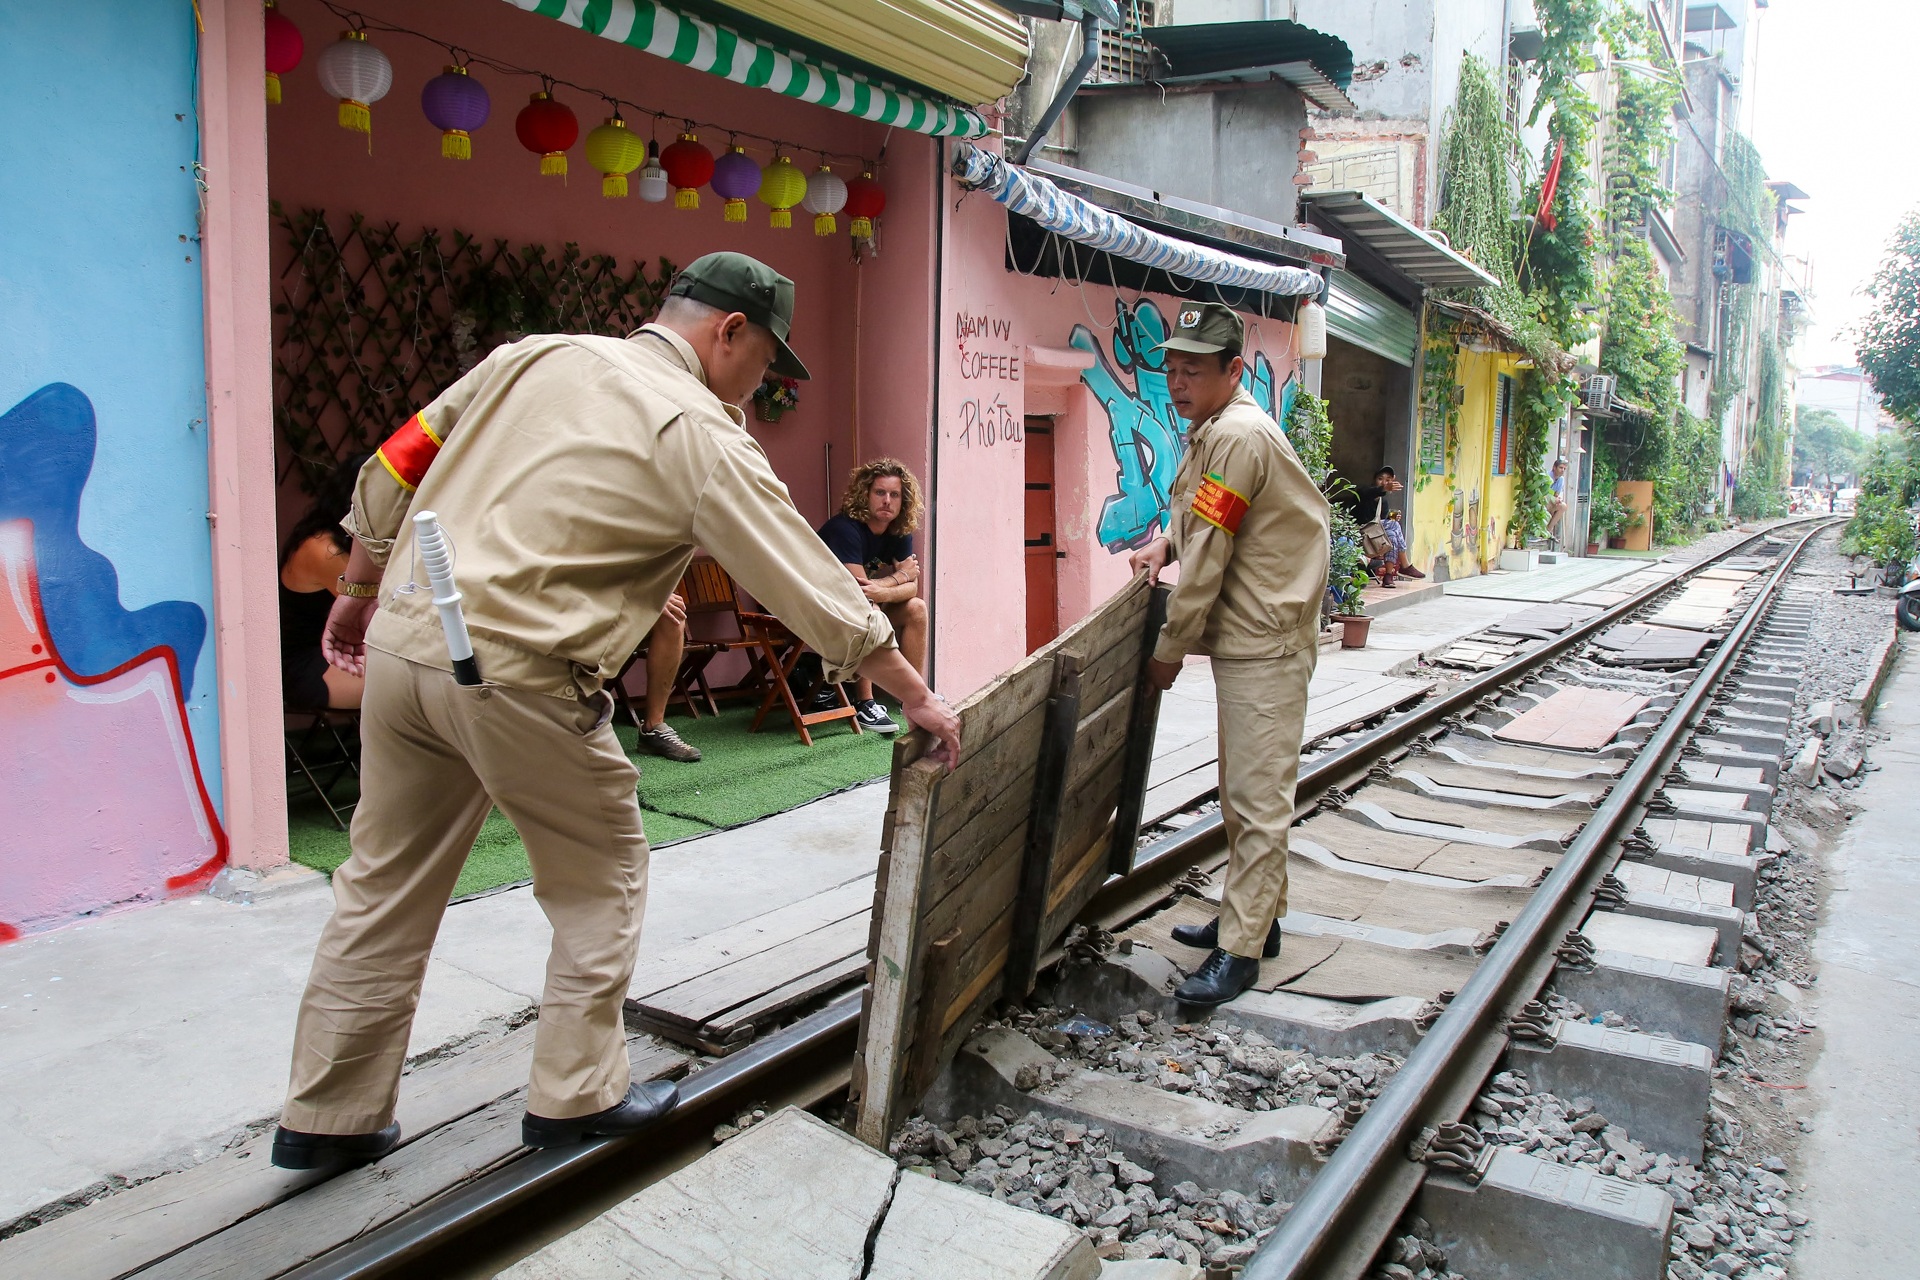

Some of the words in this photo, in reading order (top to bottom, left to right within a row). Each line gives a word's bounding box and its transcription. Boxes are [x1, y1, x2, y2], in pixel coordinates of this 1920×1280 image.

[956, 312, 989, 339] NAM
[992, 319, 1011, 341] VY
[960, 351, 1019, 381] COFFEE
[959, 392, 1000, 449] Phố
[997, 403, 1022, 443] Tàu
